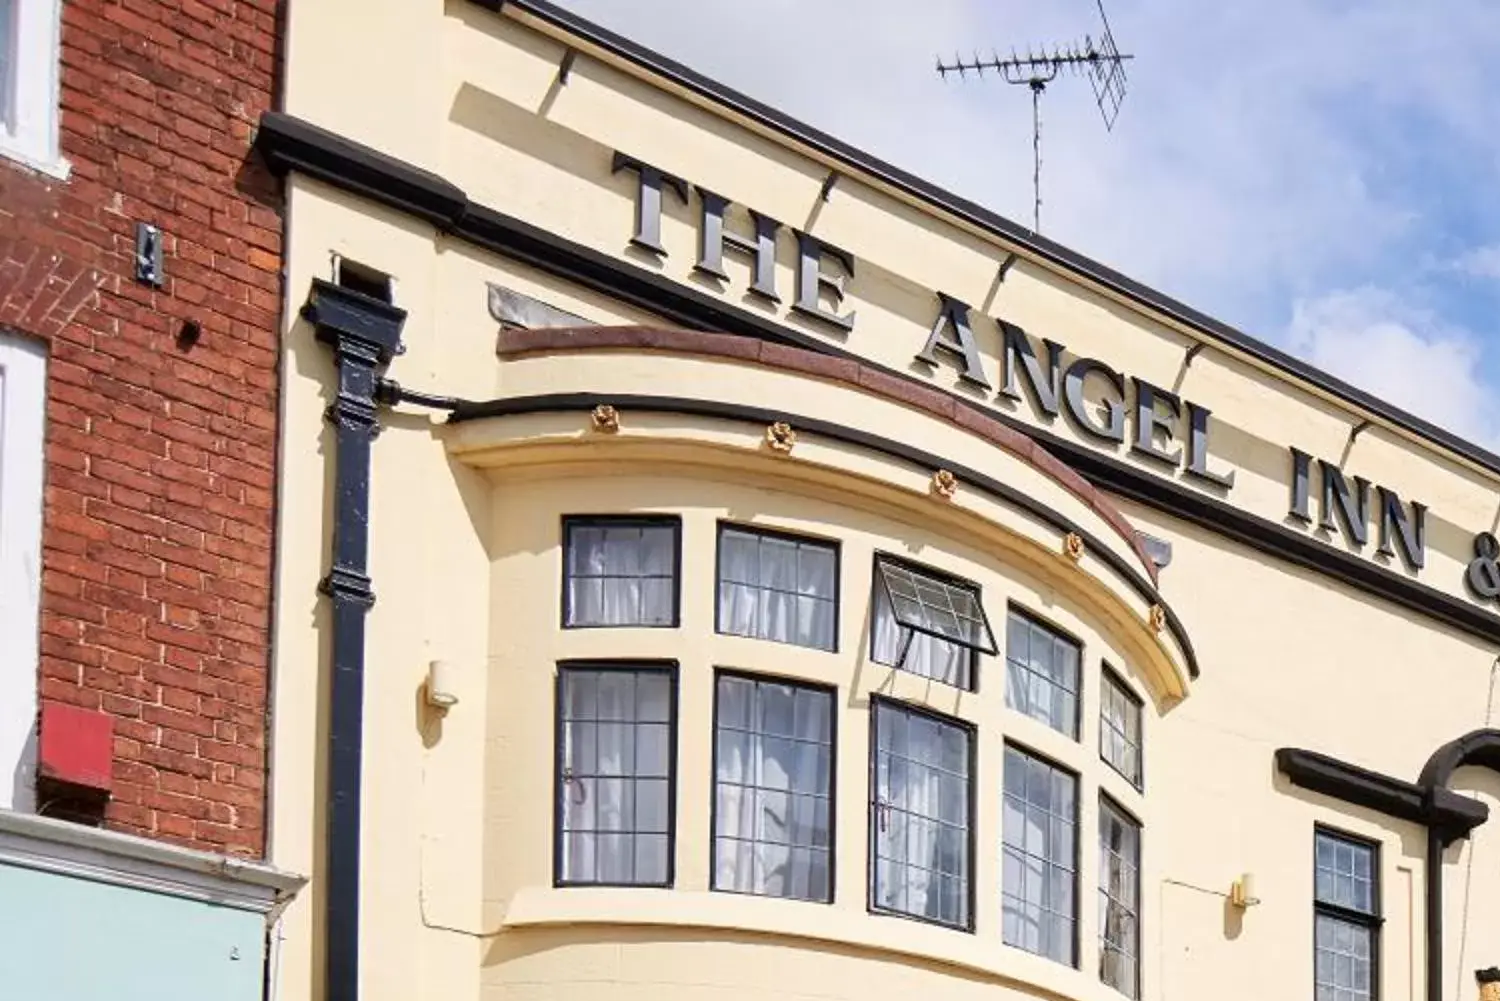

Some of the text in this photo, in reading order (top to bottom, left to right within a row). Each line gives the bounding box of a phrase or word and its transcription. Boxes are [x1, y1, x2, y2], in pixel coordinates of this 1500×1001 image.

[612, 149, 856, 332] THE
[915, 291, 1236, 489] ANGEL
[1288, 446, 1427, 570] INN
